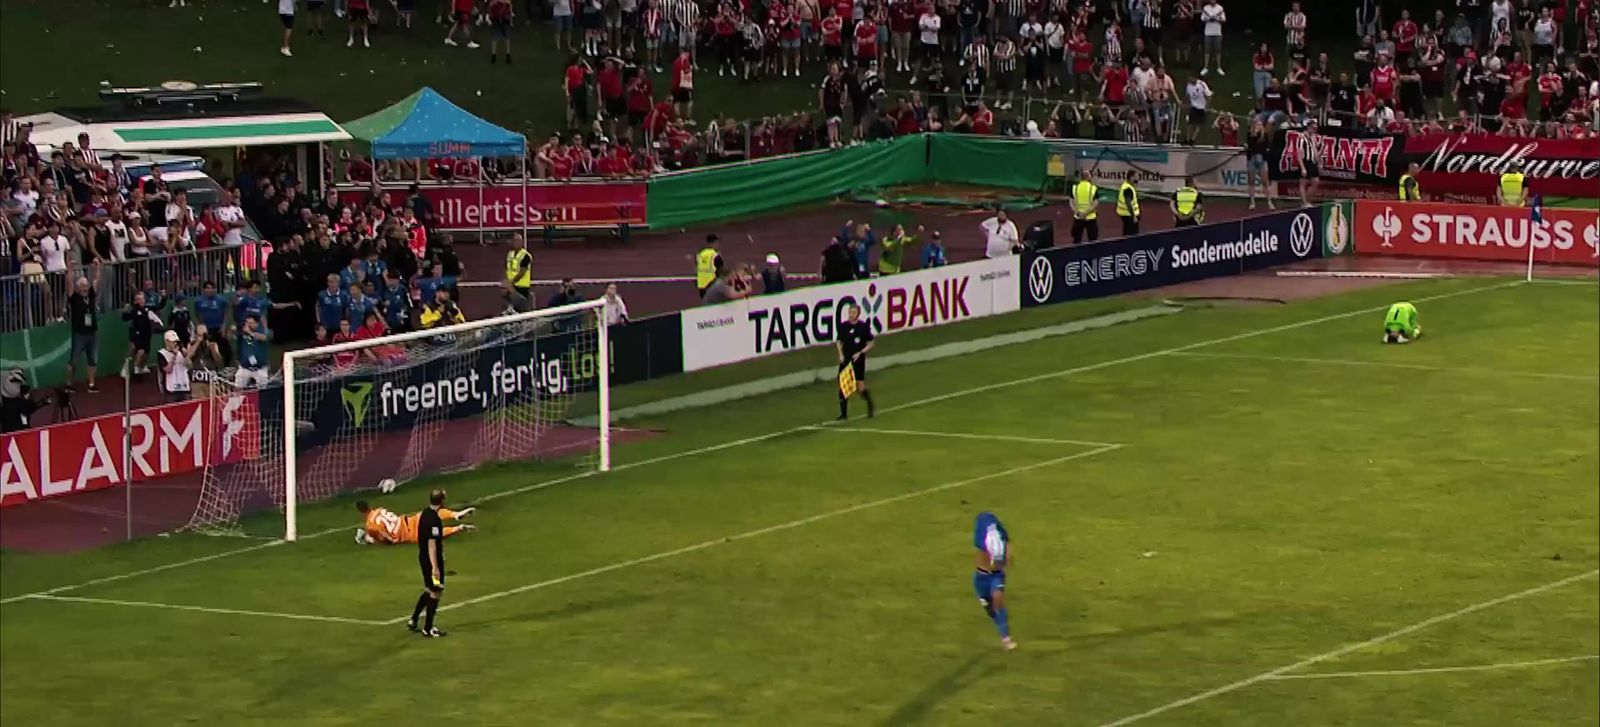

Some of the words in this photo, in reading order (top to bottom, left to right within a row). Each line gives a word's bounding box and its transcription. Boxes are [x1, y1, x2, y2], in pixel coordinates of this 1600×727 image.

[1065, 249, 1164, 287] ENERGY
[1171, 231, 1278, 269] Sondermodelle
[1411, 213, 1574, 250] STRAUSS
[381, 369, 488, 417] freenet,
[490, 352, 567, 396] fertig,
[571, 340, 615, 379] lo!
[0, 403, 203, 500] ALARM
